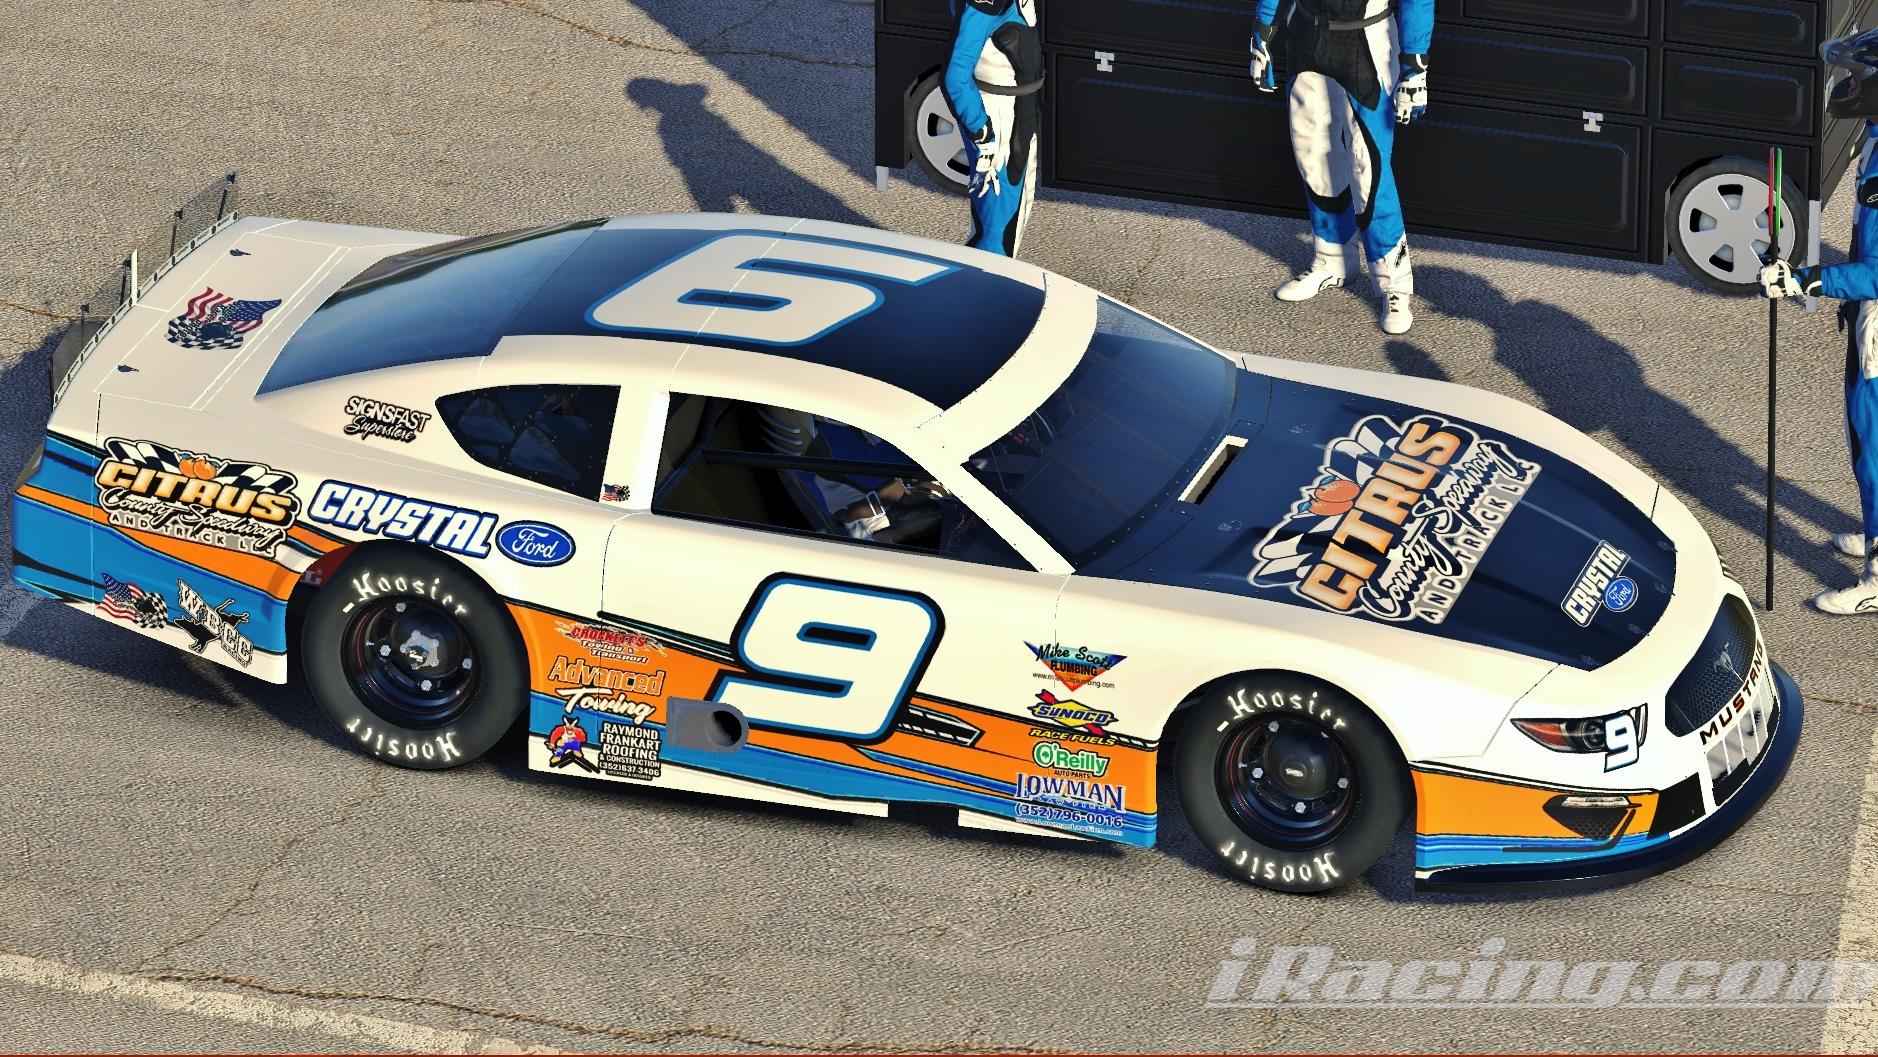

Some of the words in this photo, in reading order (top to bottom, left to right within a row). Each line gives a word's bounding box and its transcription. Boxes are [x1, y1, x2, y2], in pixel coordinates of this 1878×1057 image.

[344, 396, 432, 432] SIGNSFAST
[344, 414, 416, 442] Superstore
[98, 460, 297, 527] CITRUS
[102, 487, 182, 529] County
[179, 503, 284, 548] Speedway
[111, 512, 148, 529] AND
[163, 524, 226, 546] TRACK
[310, 481, 498, 557] CRYSTAL
[511, 526, 558, 561] Ford
[1299, 420, 1464, 612] CITRUS
[1358, 528, 1454, 618] County
[1411, 441, 1514, 534] Speedway
[1423, 577, 1456, 621] AND
[1456, 498, 1507, 563] TRACK
[352, 571, 468, 615] Hoosier
[1563, 542, 1628, 624] CRYSTAL
[1608, 582, 1632, 606] Ford
[177, 578, 254, 663] WBCC
[703, 571, 946, 746] 9
[1035, 642, 1071, 662] Mike
[1050, 660, 1099, 677] PLUMBING
[548, 655, 667, 697] Advanced
[1699, 638, 1764, 746] MUSTANG
[555, 686, 656, 725] Towing
[1037, 704, 1110, 724] SUNOCO
[1227, 688, 1347, 730] Hoosier
[346, 718, 463, 763] Hoosier
[599, 731, 662, 752] FRANKART
[602, 721, 660, 741] RAYMOND
[1029, 729, 1070, 741] RACE
[1069, 734, 1117, 746] FUELS
[1603, 709, 1640, 773] 9
[601, 743, 658, 761] ROOFING
[605, 754, 661, 769] CONSTRUCTION
[1034, 743, 1108, 776] O'Reilly
[1053, 768, 1070, 777] AUTO
[1071, 771, 1092, 780] PARTS
[1014, 802, 1123, 828] (352)796-0016
[1220, 842, 1341, 885] Hoosier
